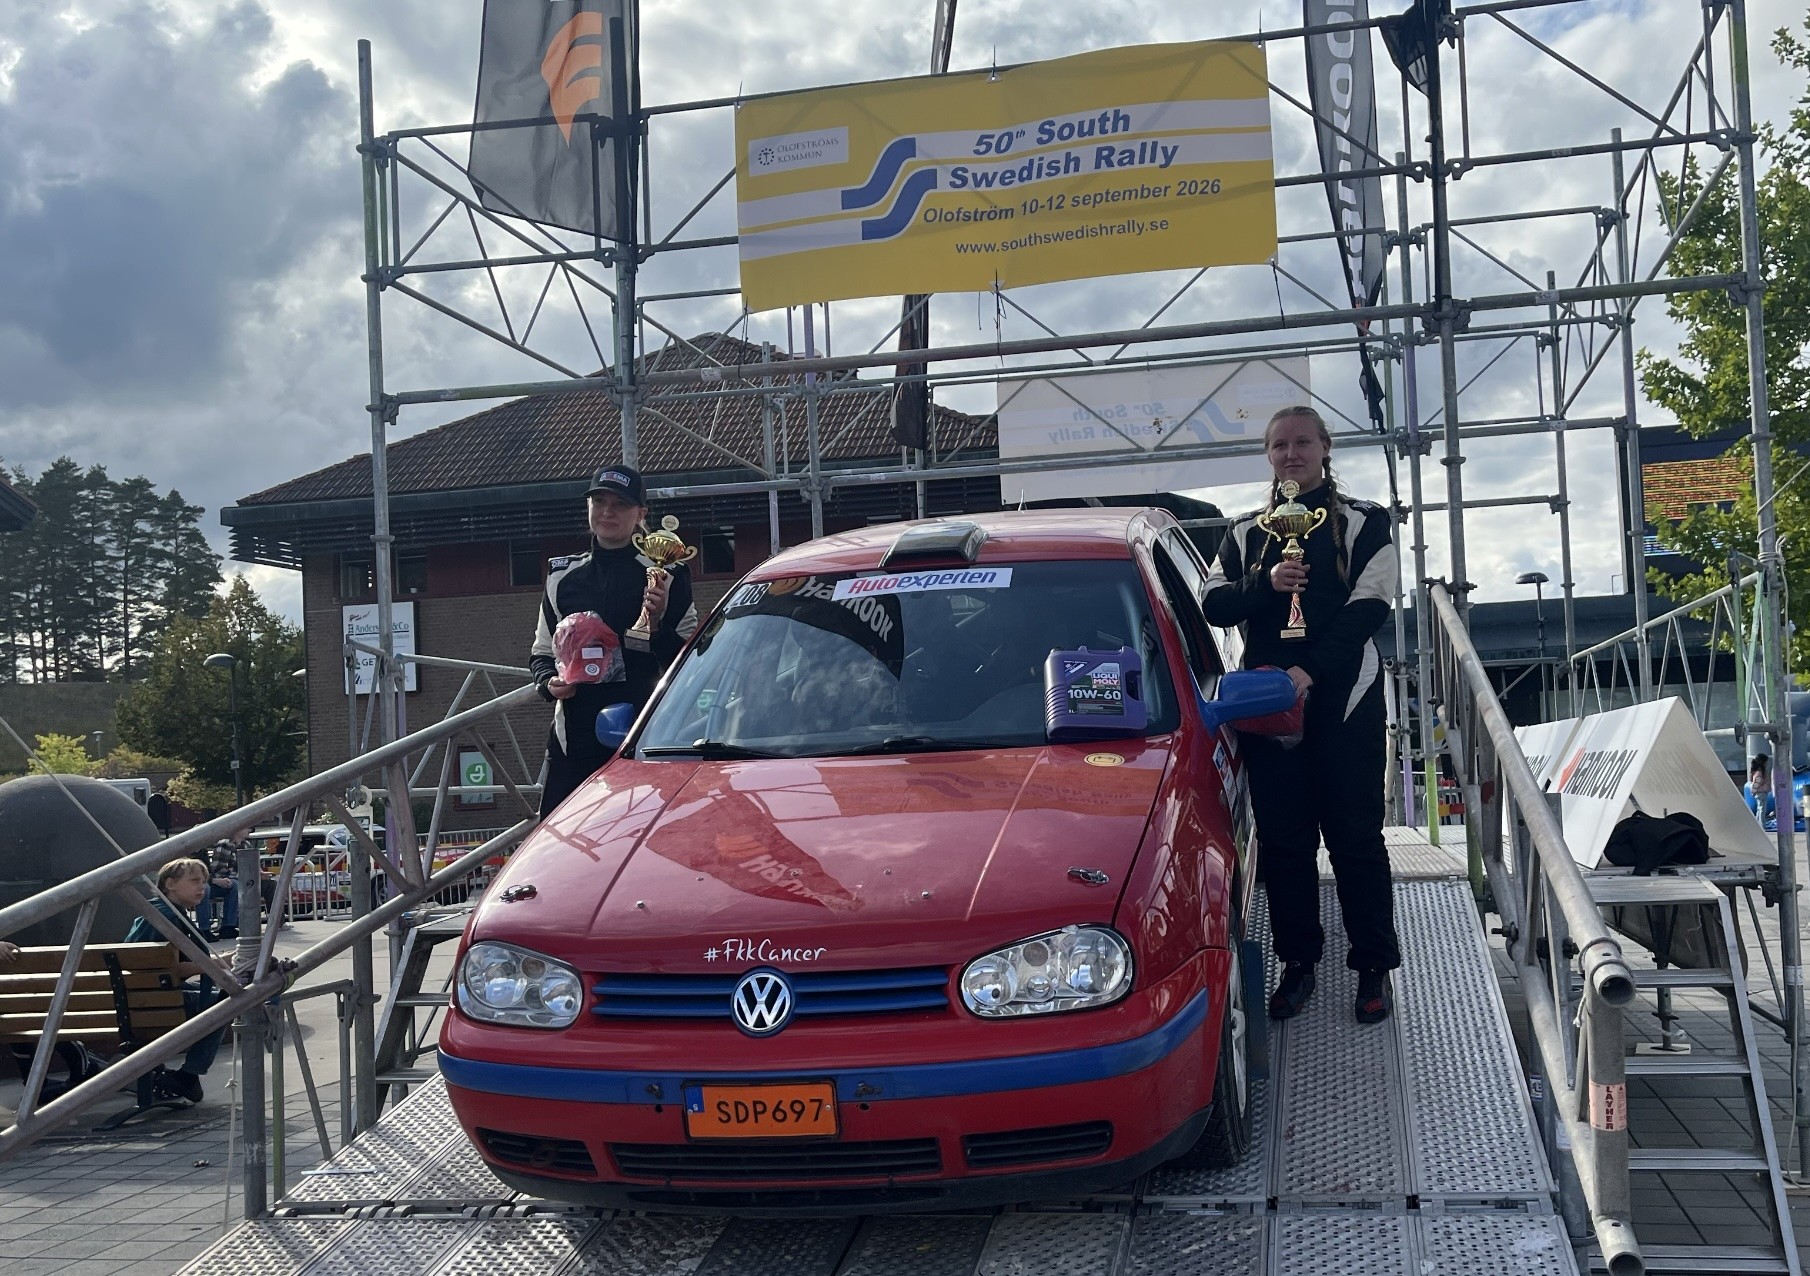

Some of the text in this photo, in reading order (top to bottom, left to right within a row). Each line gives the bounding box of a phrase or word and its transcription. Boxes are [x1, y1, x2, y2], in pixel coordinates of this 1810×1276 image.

[1035, 109, 1131, 145] South
[777, 150, 822, 163] KOMMUN
[948, 142, 1179, 189] Swedish Rally
[923, 178, 1221, 224] Olofström 10-12 september 2026
[955, 217, 1169, 255] www.southswedishrally.se
[848, 570, 997, 594] Autoexperten
[1067, 689, 1121, 700] 10W-60
[703, 938, 828, 963] #FkkCancer
[733, 972, 791, 1031] VW
[716, 1098, 825, 1124] SDP697
[1605, 1086, 1614, 1130] LAYHER
